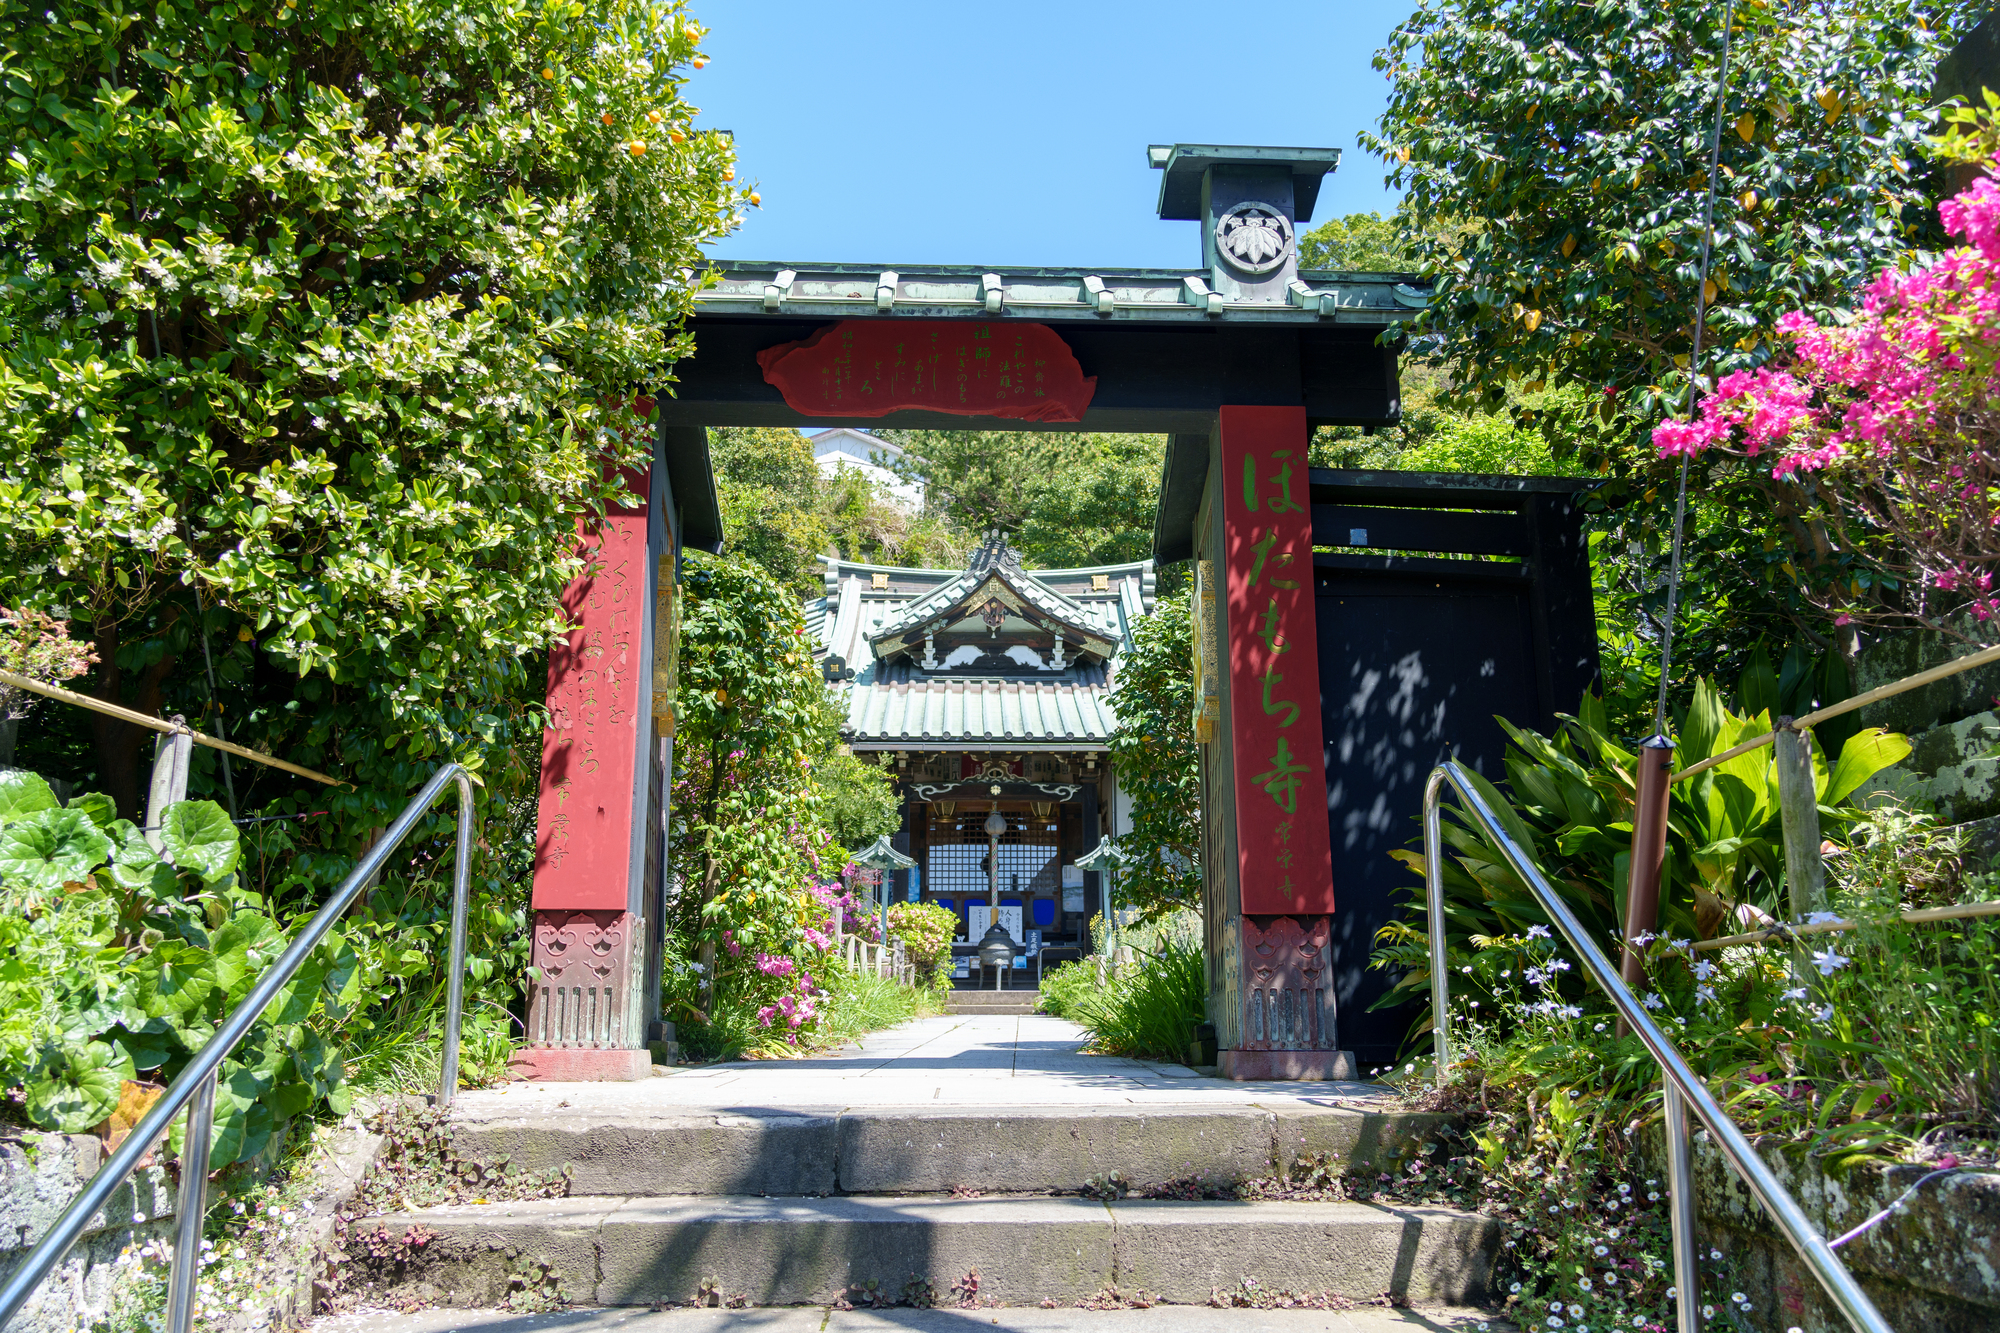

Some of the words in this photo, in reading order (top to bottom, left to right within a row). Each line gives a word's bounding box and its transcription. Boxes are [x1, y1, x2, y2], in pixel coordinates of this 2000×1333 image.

[1243, 449, 1312, 814] ぼたもち寺
